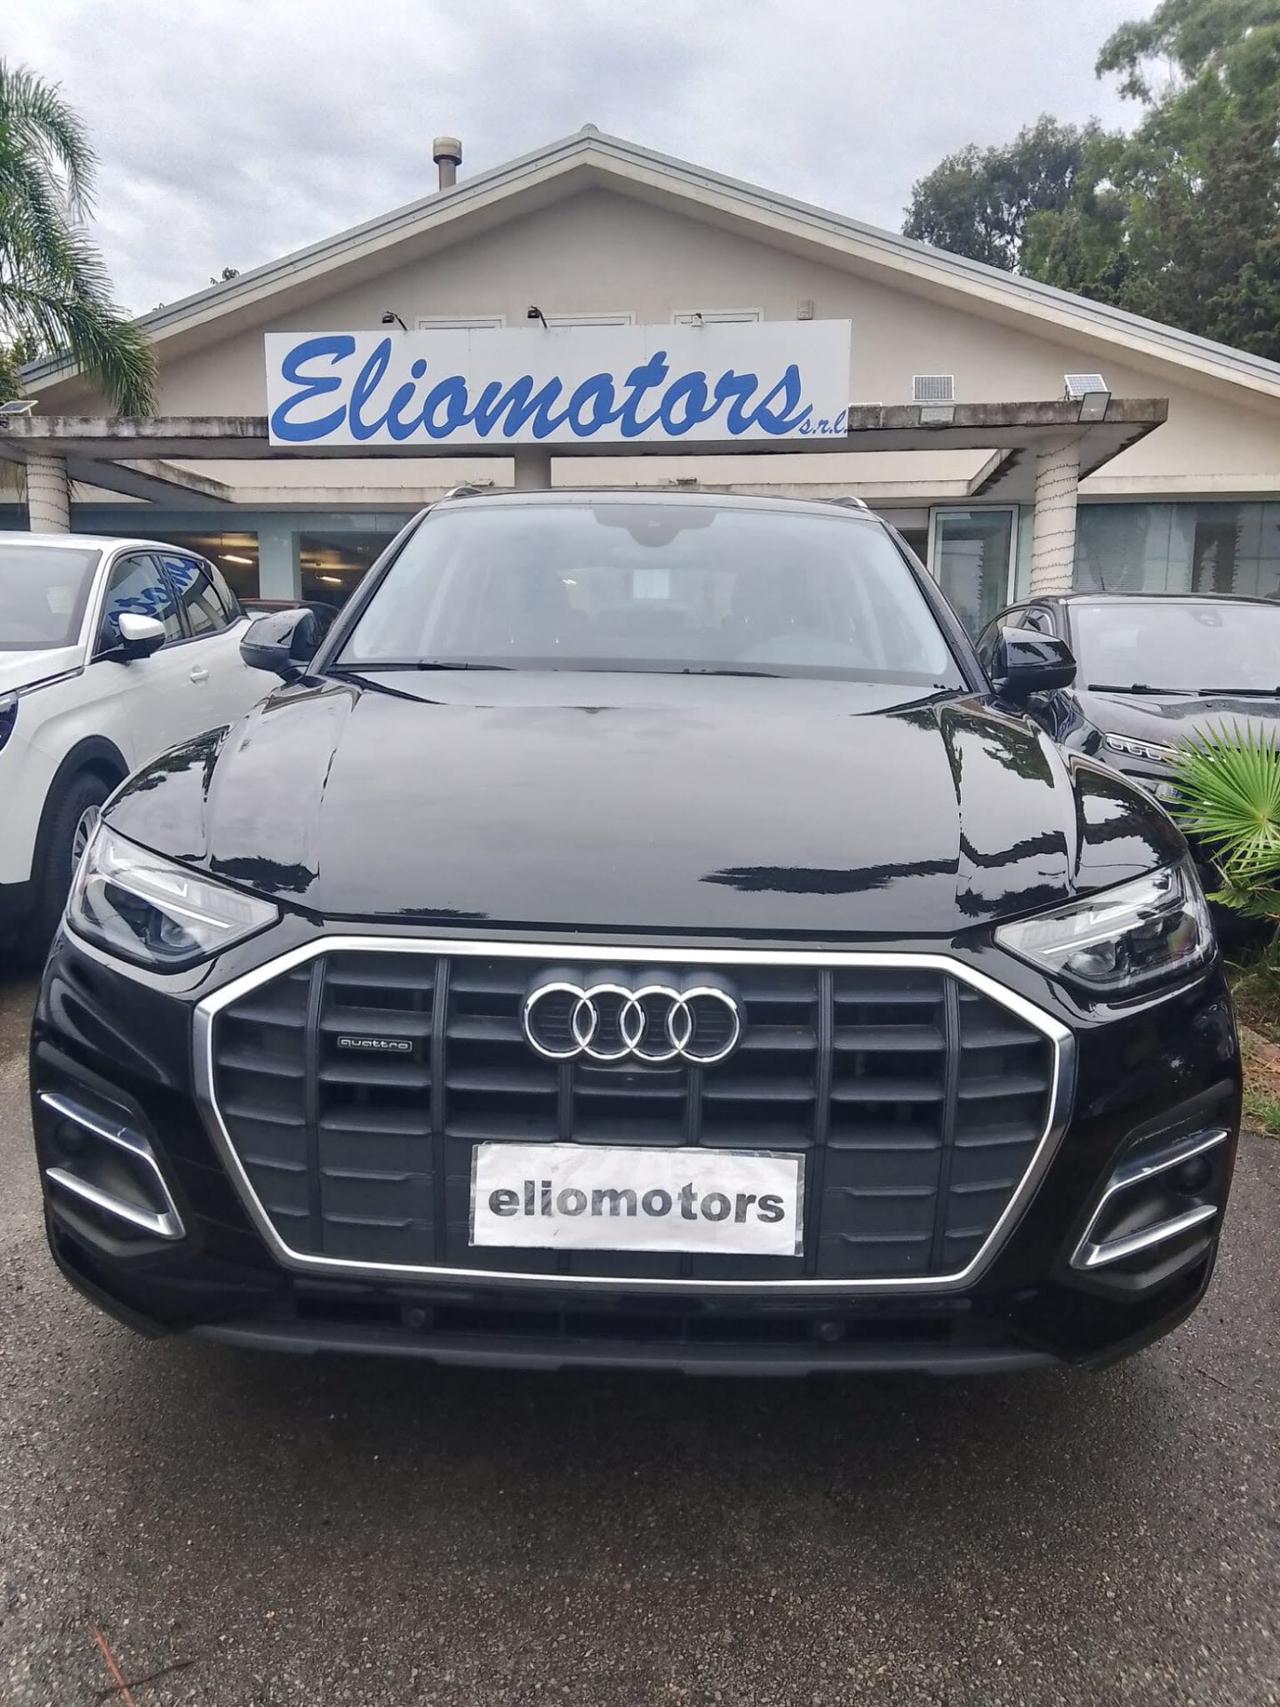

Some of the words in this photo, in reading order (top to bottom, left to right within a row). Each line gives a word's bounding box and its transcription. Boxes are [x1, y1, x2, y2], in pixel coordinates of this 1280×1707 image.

[270, 335, 813, 442] Eliomotors
[340, 1039, 409, 1050] quattro
[488, 1180, 785, 1223] eliomotors
